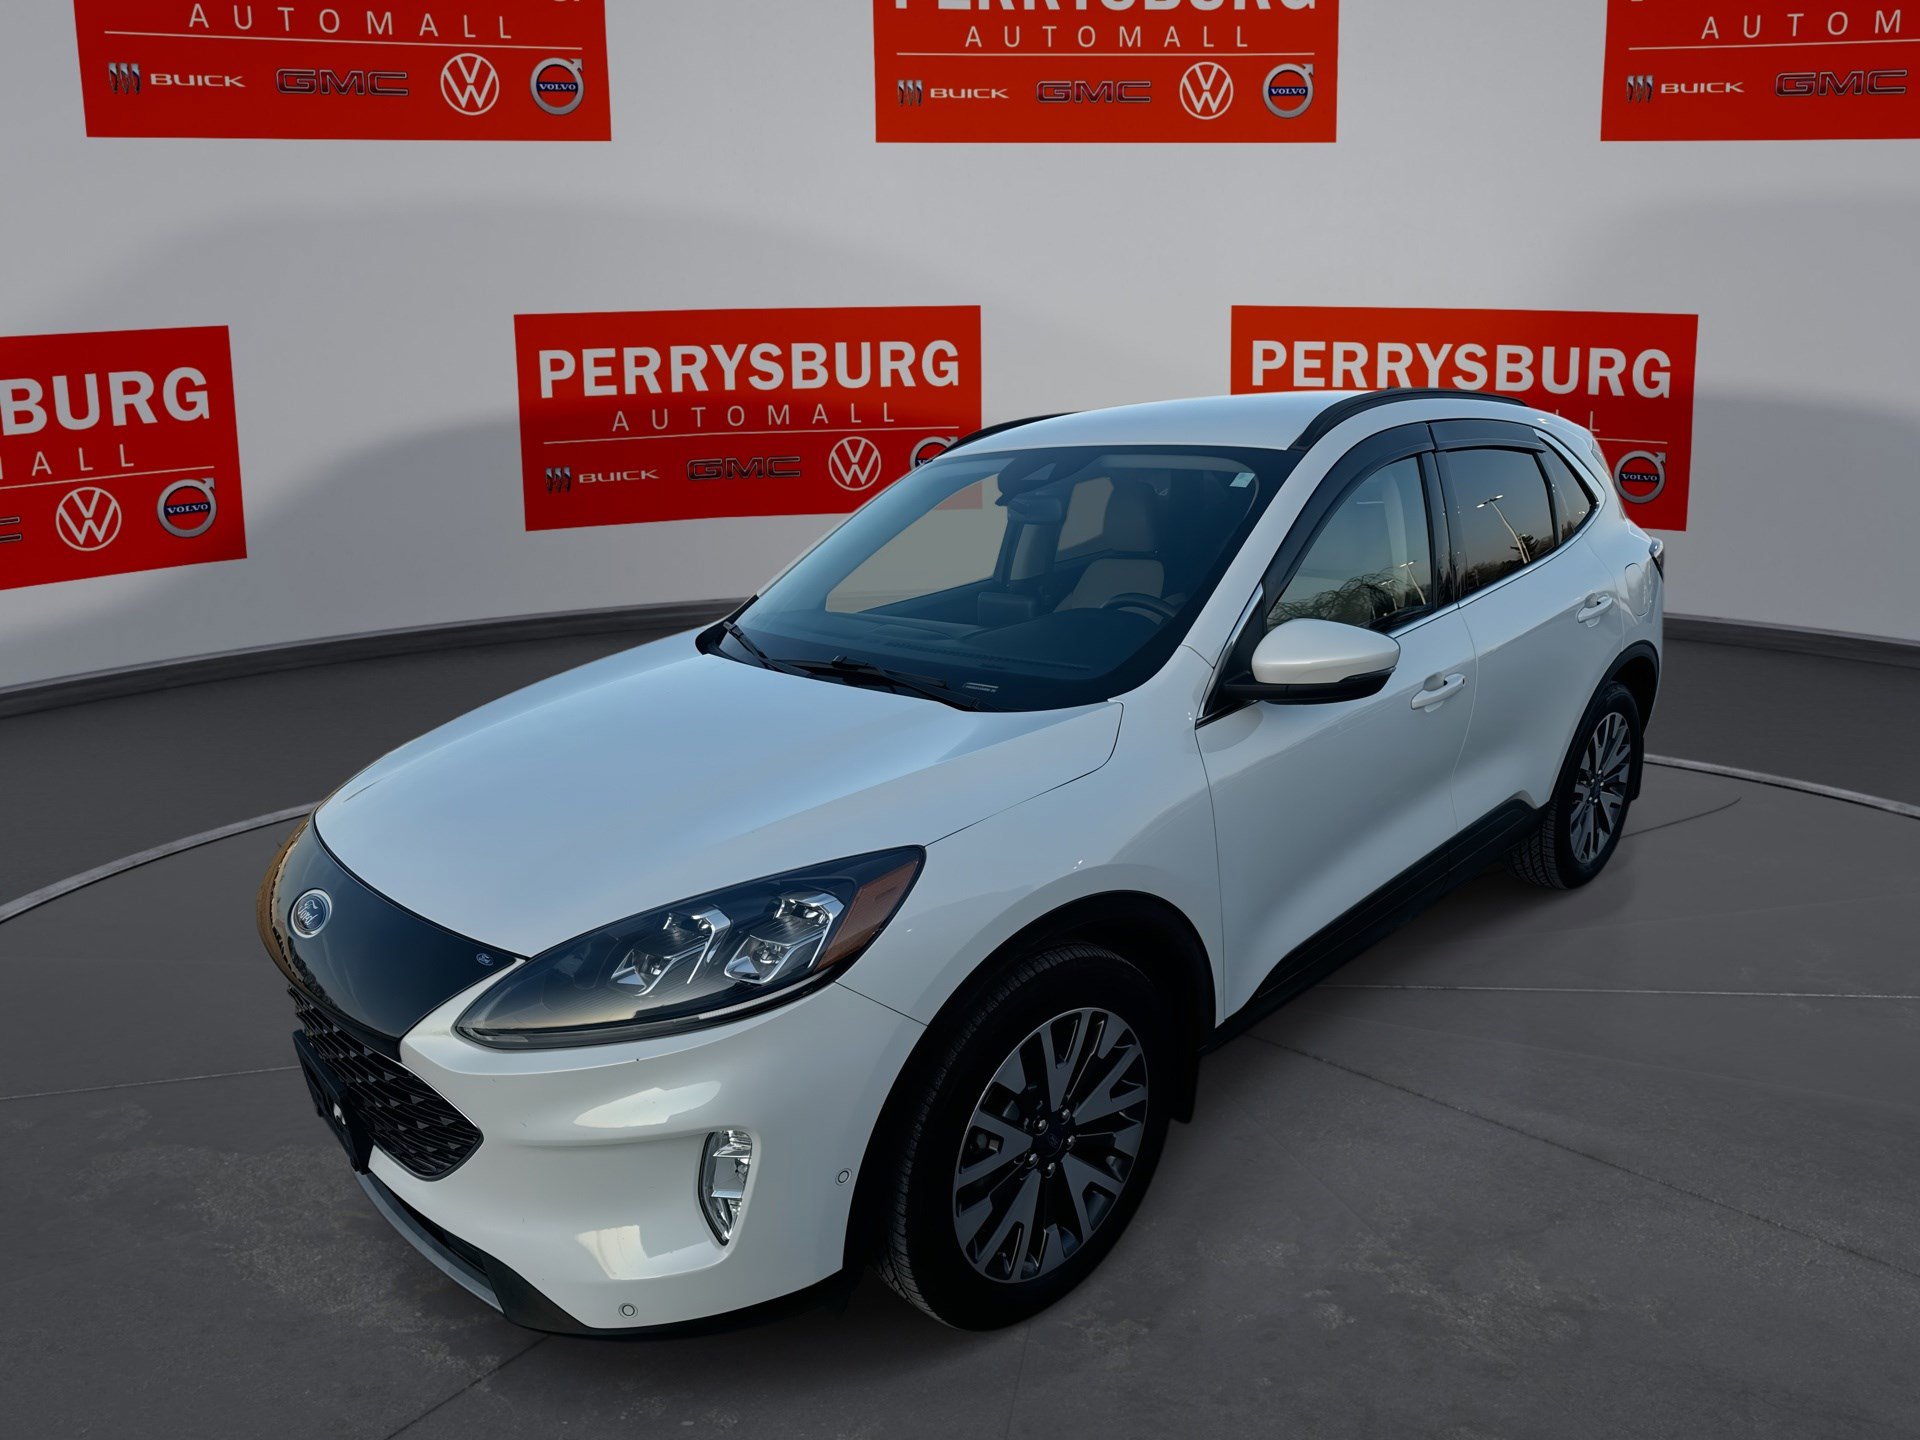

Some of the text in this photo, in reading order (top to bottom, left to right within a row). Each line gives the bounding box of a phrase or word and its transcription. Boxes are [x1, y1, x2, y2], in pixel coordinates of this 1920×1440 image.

[188, 3, 512, 39] AUTOMALL
[965, 26, 1248, 48] AUTOMALL
[150, 74, 246, 88] BUICK
[276, 68, 409, 96] GMC
[538, 81, 577, 92] VOLVO
[930, 88, 1010, 99] BUICK
[1036, 80, 1151, 103] GMC
[1271, 86, 1306, 96] VOLVO
[1660, 69, 1908, 97] BUICK GMC
[538, 340, 959, 399] PERRYSBURG
[1251, 340, 1671, 398] PERRYSBURG
[612, 402, 895, 432] AUTOMALL
[578, 468, 660, 483] BUICK
[687, 455, 802, 481] GMC
[1621, 473, 1658, 482] VOLVO
[167, 502, 209, 514] VOLVO
